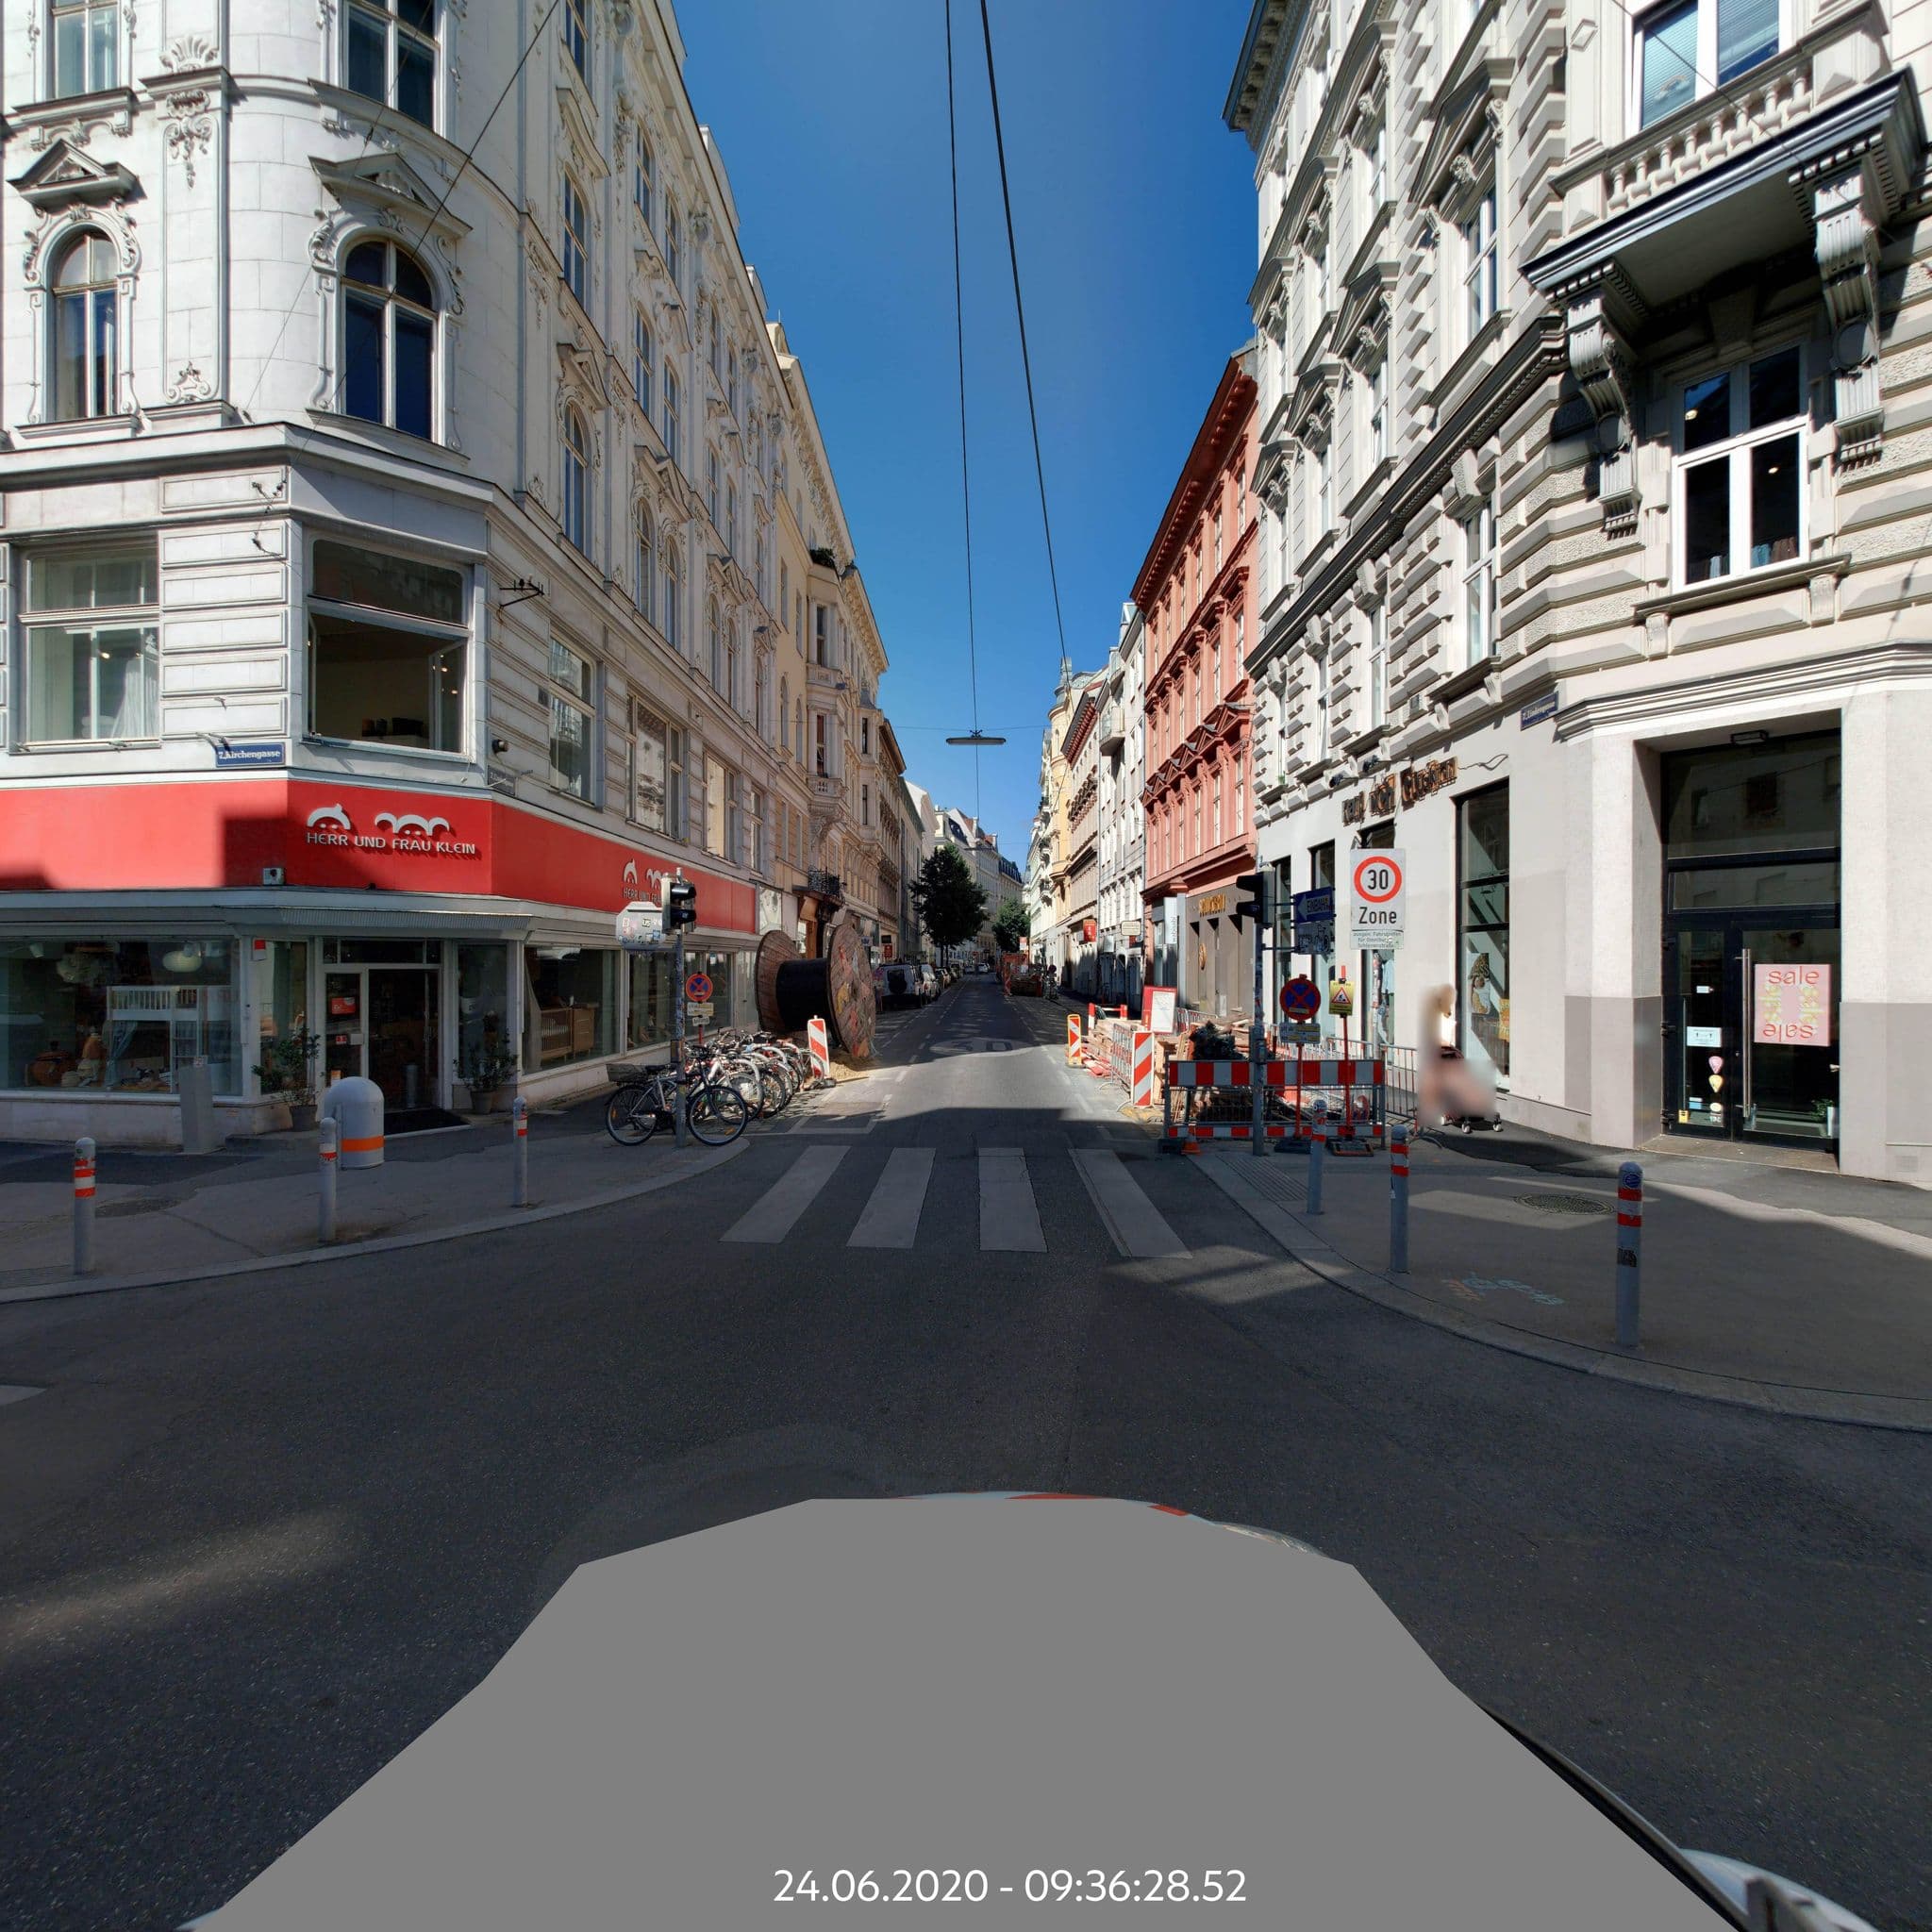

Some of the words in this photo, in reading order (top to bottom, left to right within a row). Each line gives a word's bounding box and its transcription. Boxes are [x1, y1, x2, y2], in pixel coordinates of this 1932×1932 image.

[307, 832, 348, 845] HERR
[354, 836, 386, 848] UND
[391, 839, 431, 852] FRAU
[436, 841, 475, 855] KLEIN
[1367, 869, 1389, 890] 30
[1358, 907, 1397, 924] Zone
[1768, 965, 1820, 985] sale
[1762, 1023, 1813, 1042] sale
